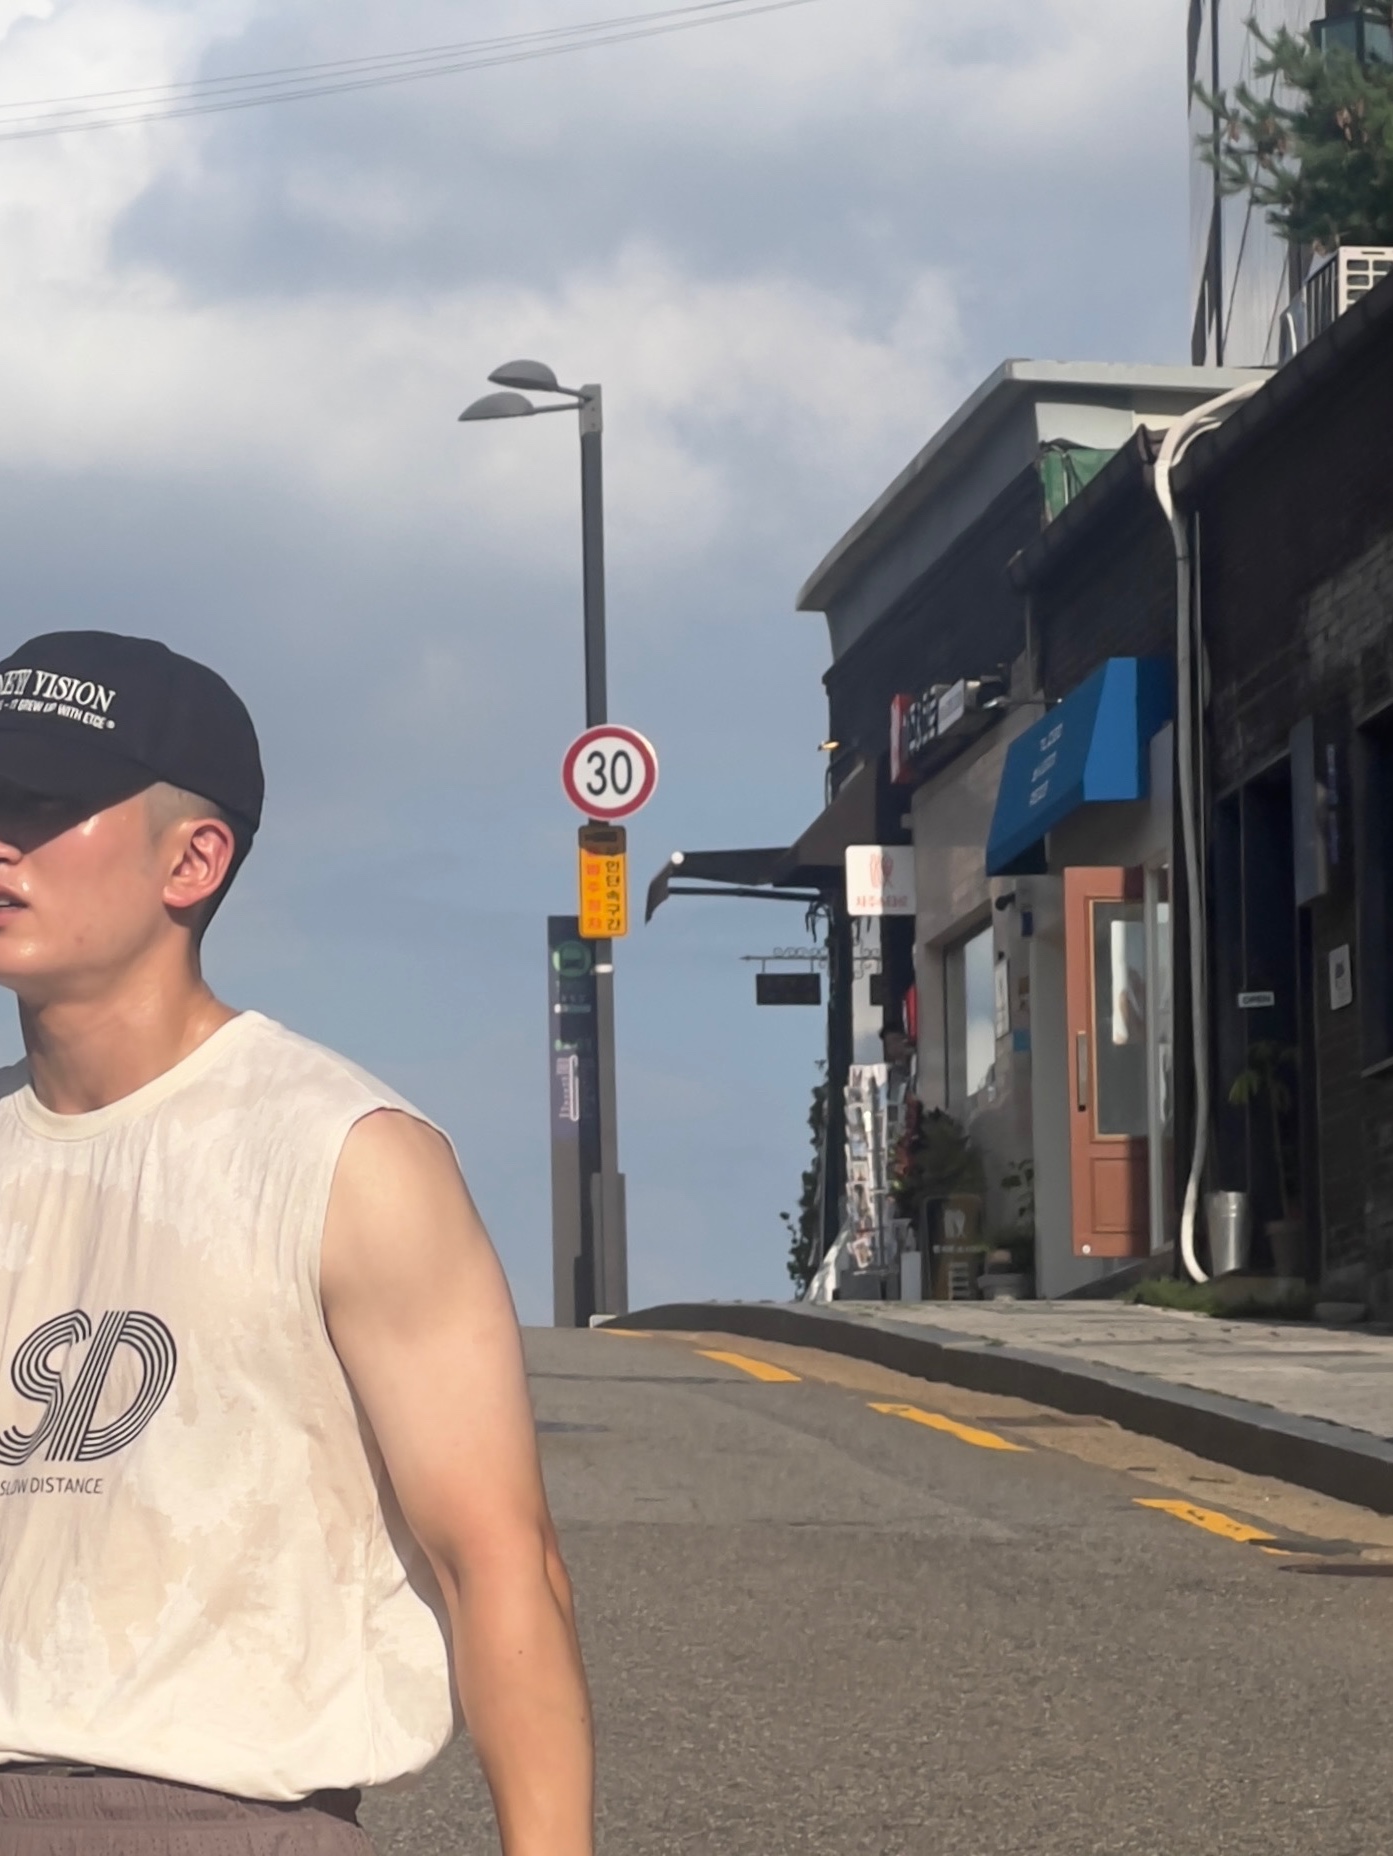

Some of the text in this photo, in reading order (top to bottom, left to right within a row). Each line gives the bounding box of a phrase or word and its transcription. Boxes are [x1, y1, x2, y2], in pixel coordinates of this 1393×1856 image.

[32, 670, 116, 712] VISION
[57, 703, 83, 721] WITH
[586, 750, 633, 796] 30
[29, 1476, 104, 1494] DISTANCE
